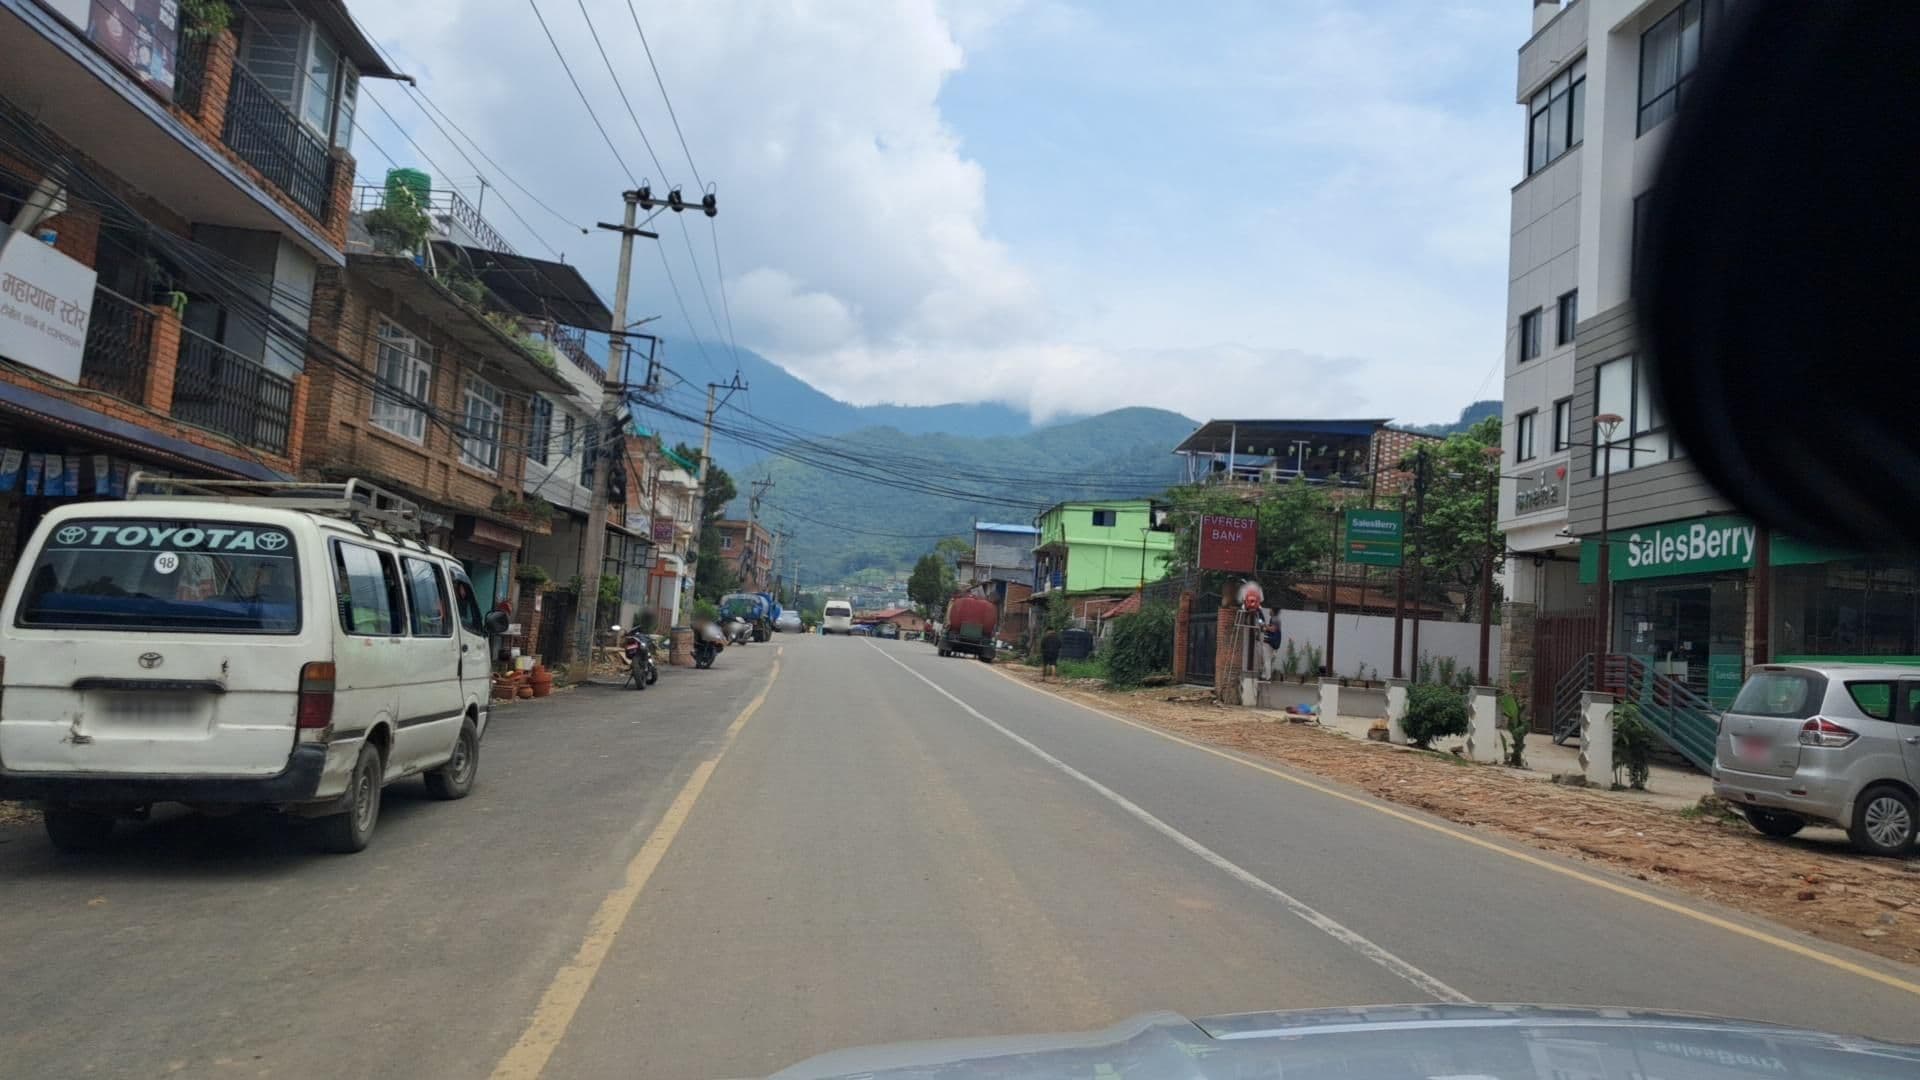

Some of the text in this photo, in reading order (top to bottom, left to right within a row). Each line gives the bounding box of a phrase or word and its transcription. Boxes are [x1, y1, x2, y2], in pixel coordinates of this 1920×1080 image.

[2, 272, 57, 315] महायान
[60, 299, 88, 332] स्टोर
[1203, 515, 1256, 529] EVEREST
[89, 526, 255, 550] TOYOTA
[1628, 523, 1757, 567] SalesBerry
[158, 555, 176, 569] 98
